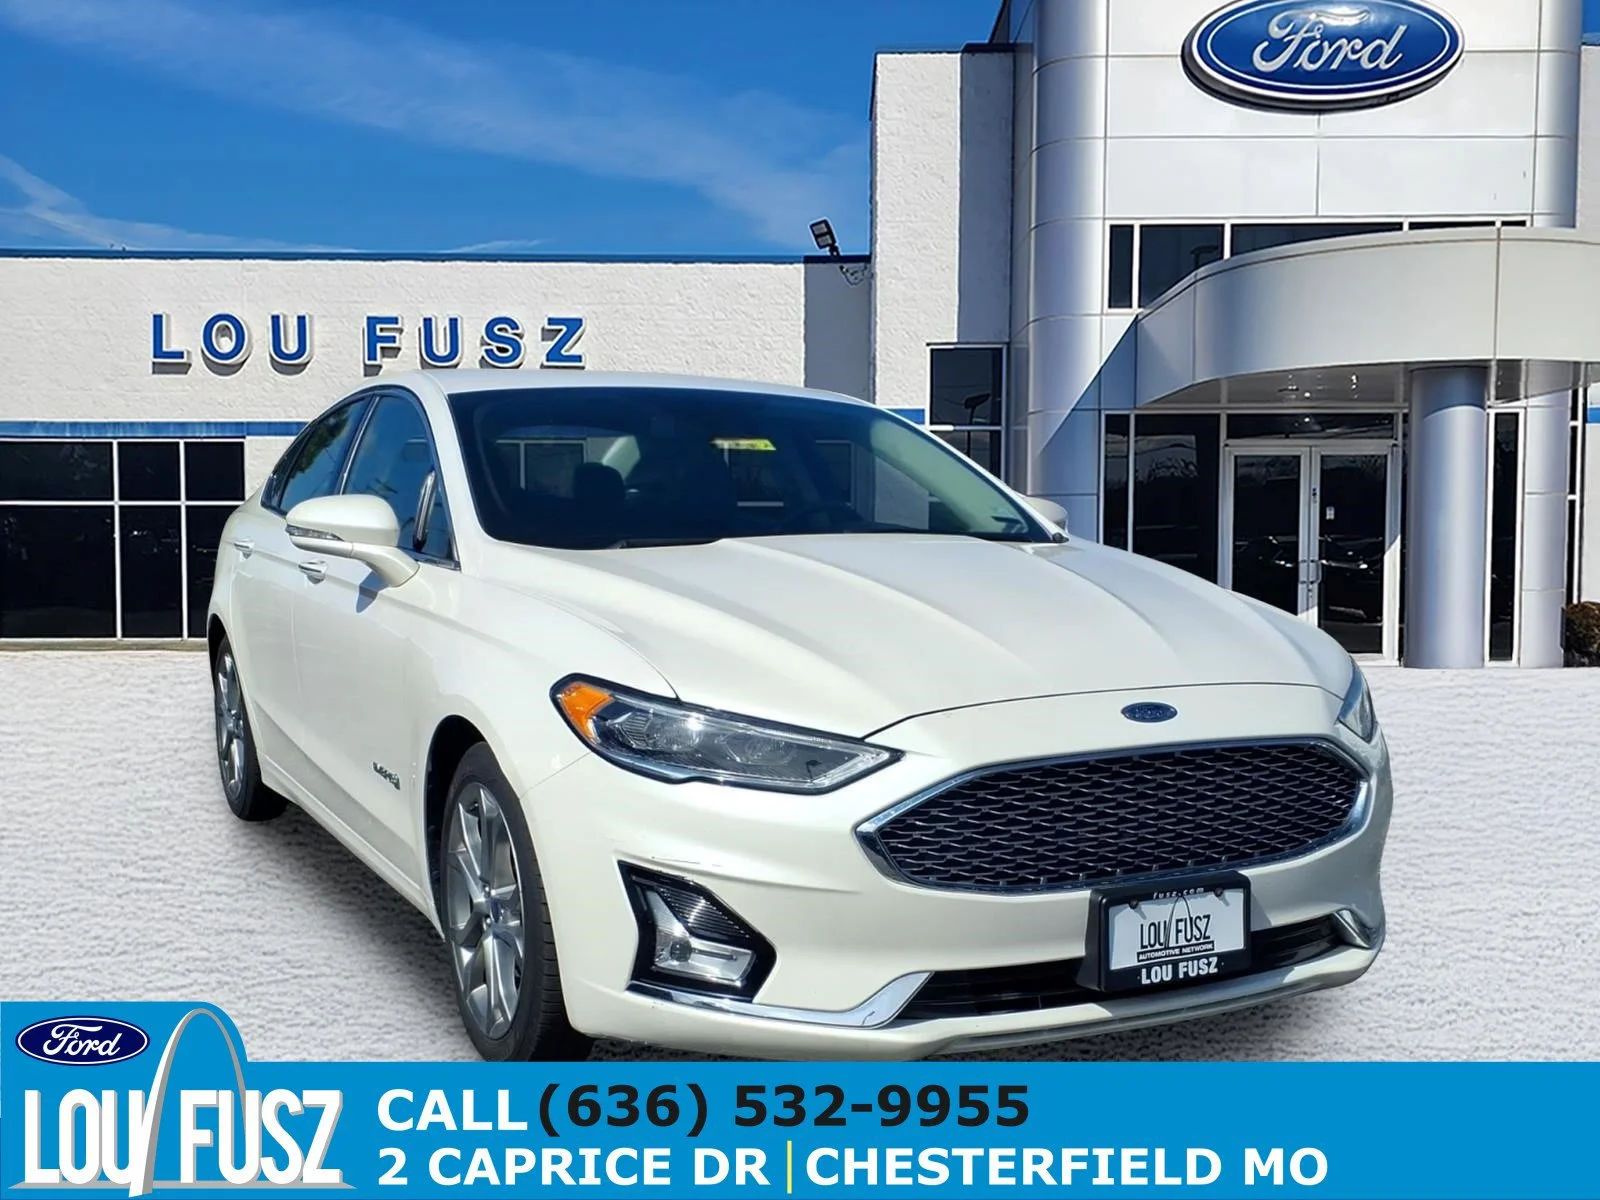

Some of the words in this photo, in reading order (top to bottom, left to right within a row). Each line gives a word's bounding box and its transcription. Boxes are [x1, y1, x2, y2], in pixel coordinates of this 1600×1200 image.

[1253, 9, 1407, 72] Ford
[152, 313, 310, 370] LOU
[365, 315, 586, 370] FUSZ
[1140, 919, 1167, 949] LOU
[1175, 914, 1211, 944] FUSZ
[1139, 949, 1180, 960] AUTOMOTIVE
[1181, 943, 1214, 954] NETWORK
[1141, 964, 1172, 985] LOU
[1178, 956, 1218, 979] FUSZ
